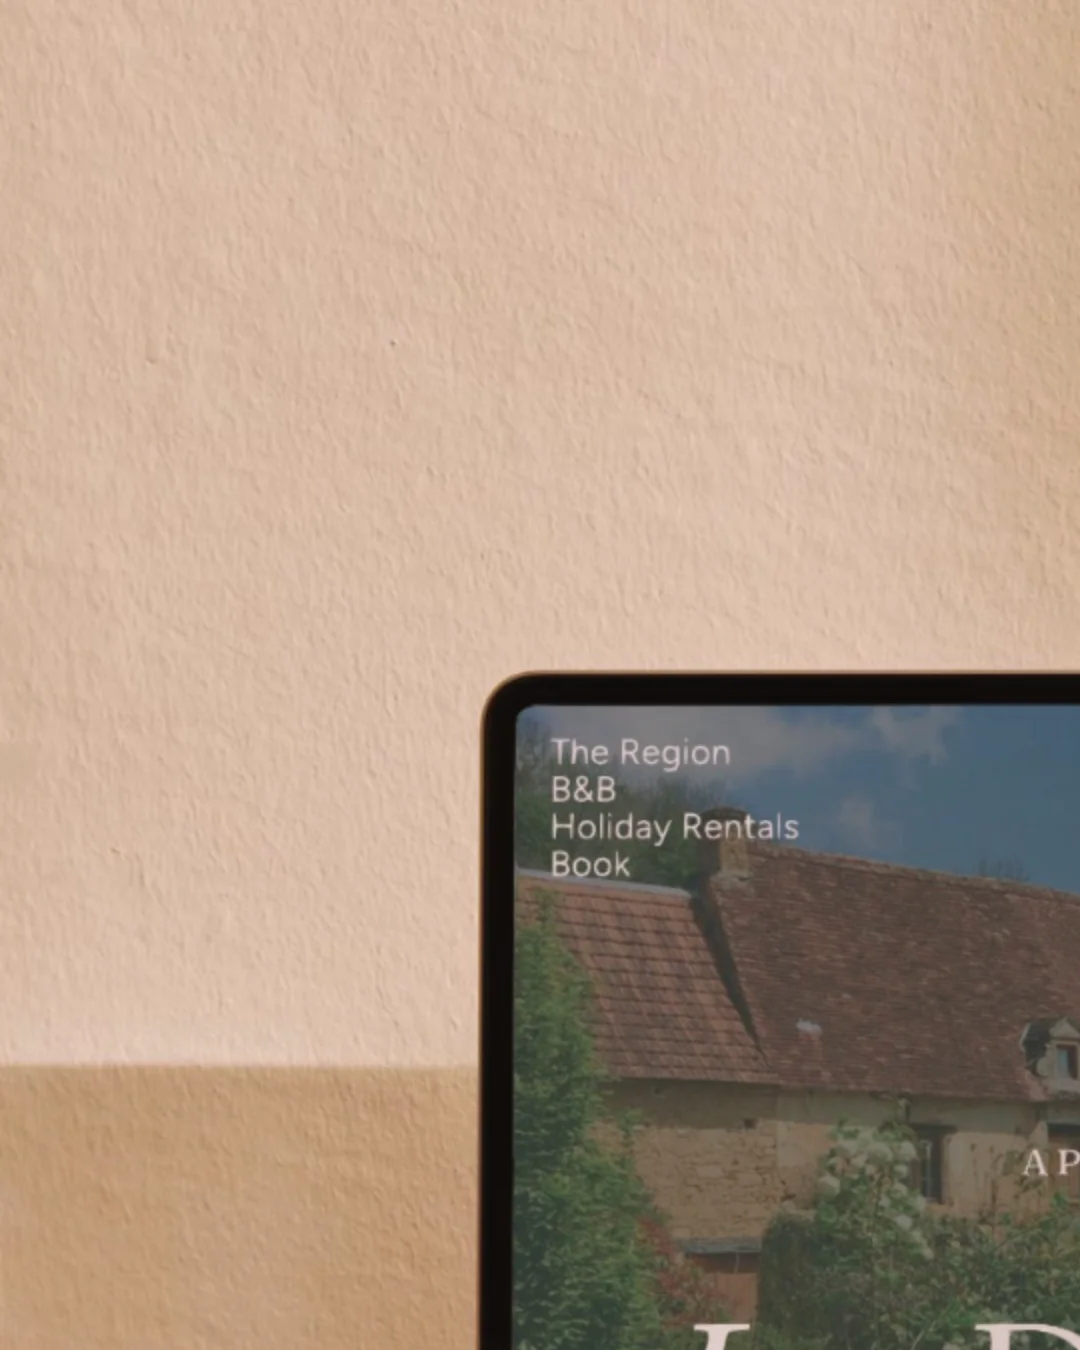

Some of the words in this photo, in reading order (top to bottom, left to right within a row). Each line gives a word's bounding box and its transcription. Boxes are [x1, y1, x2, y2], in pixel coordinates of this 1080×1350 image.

[551, 738, 609, 765] The
[620, 738, 731, 772] Region
[551, 776, 616, 803] B&B
[551, 813, 672, 846] Holiday
[683, 813, 800, 840] Rentals
[551, 850, 631, 878] Book
[1023, 1149, 1048, 1176] A
